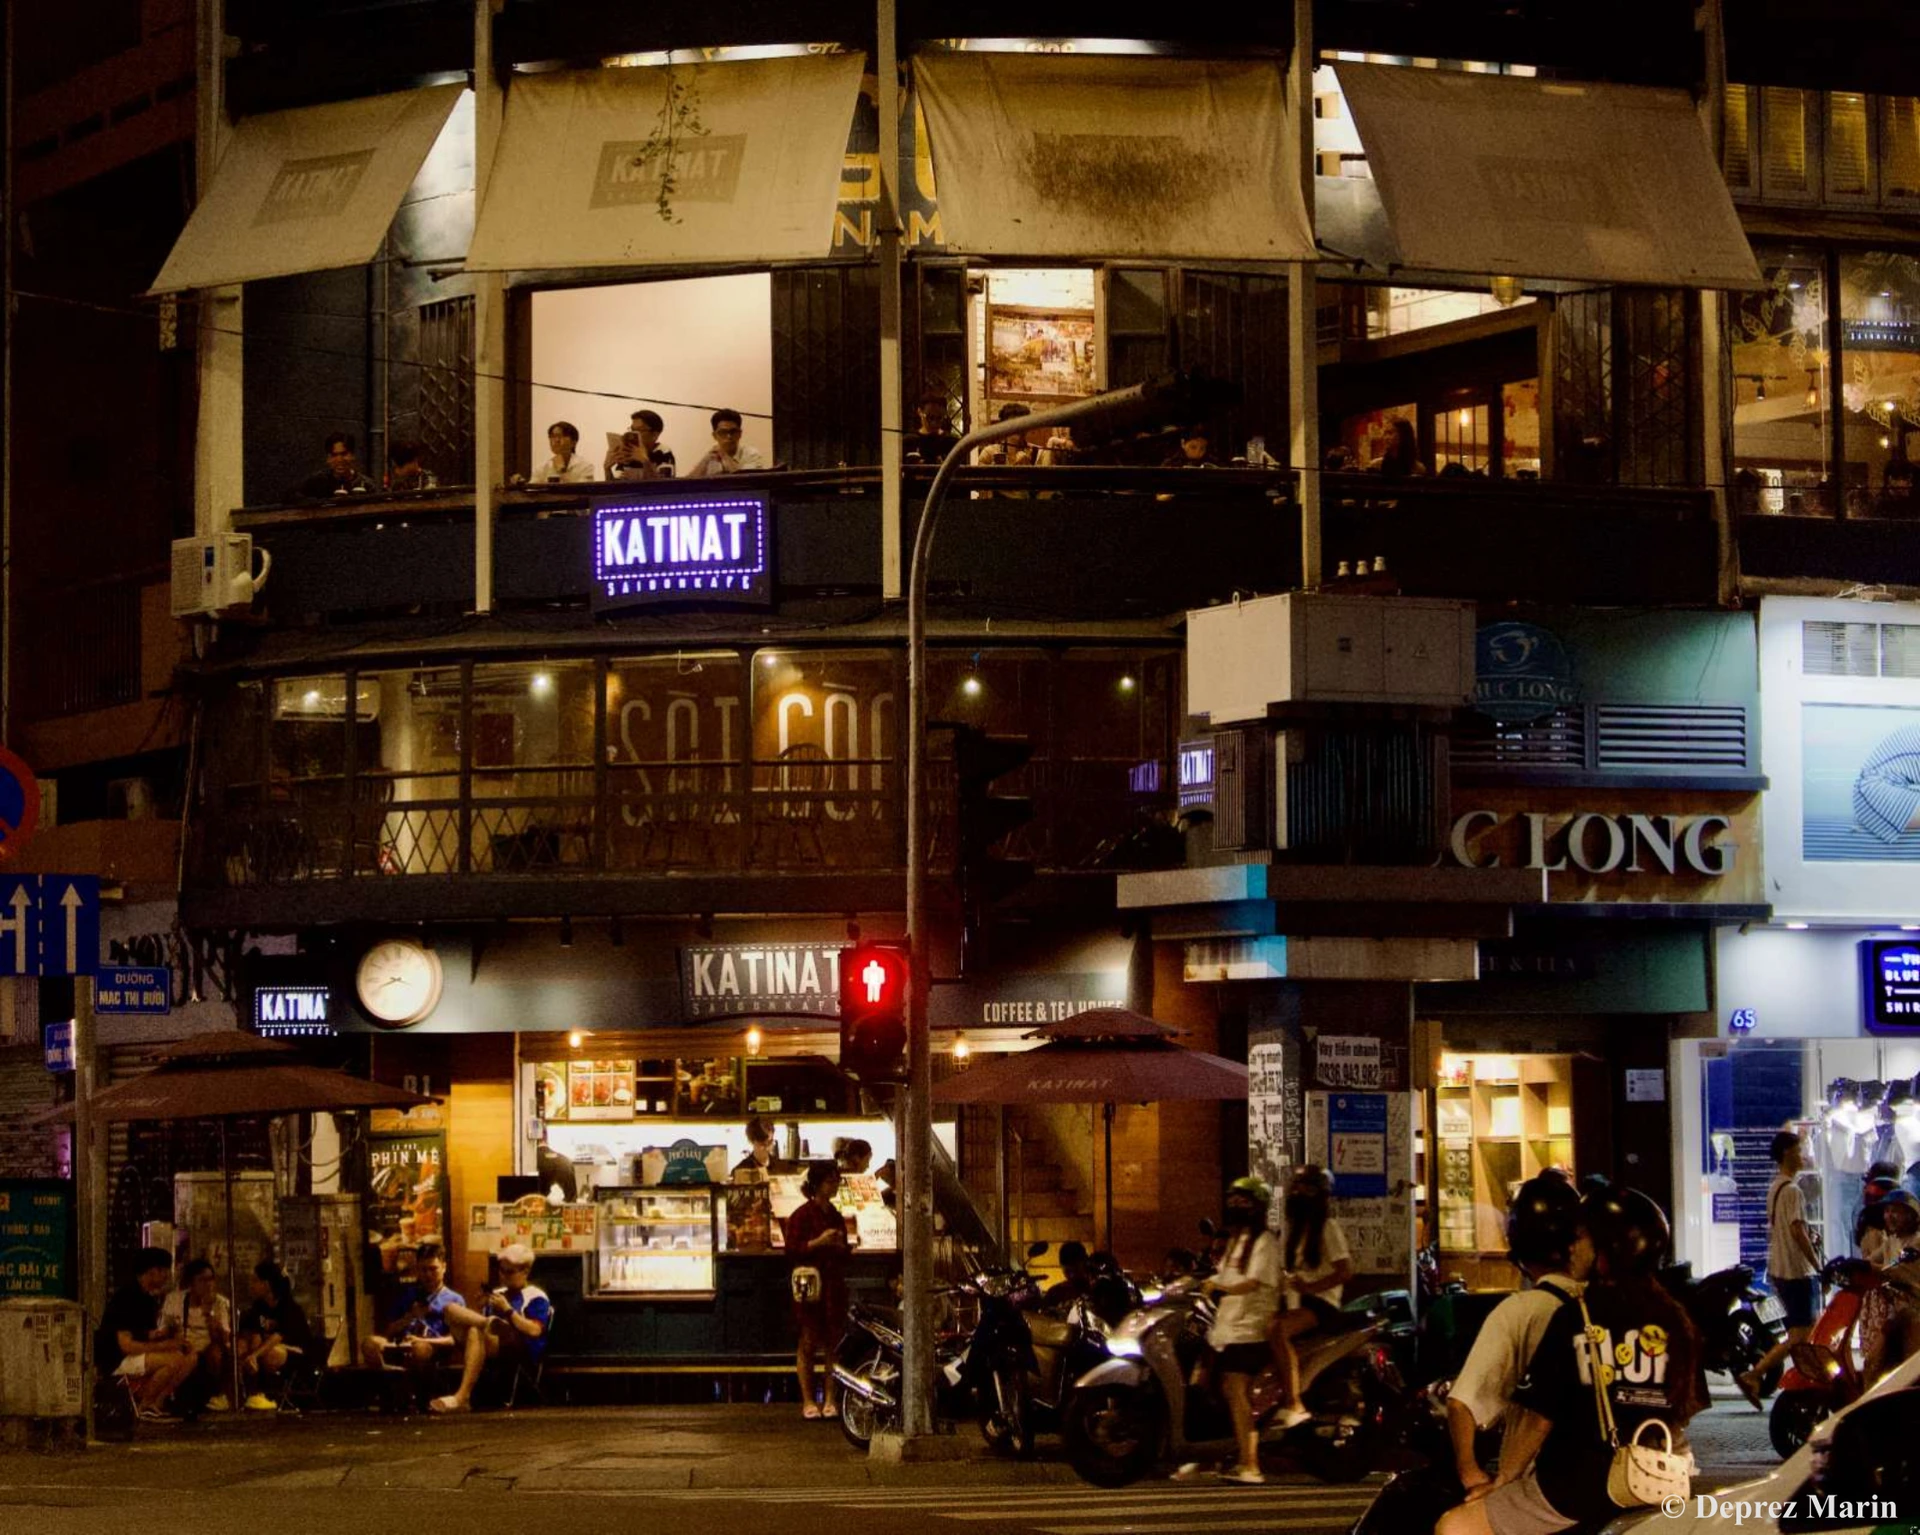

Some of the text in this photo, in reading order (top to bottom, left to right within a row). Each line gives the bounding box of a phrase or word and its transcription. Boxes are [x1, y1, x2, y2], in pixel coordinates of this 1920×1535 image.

[603, 513, 748, 566] KATINAT
[1522, 811, 1738, 876] LONG
[692, 948, 841, 996] KATINAT
[261, 993, 330, 1021] KATINA
[983, 1002, 1033, 1022] COFFEE
[1036, 1002, 1048, 1022] &
[1732, 1008, 1758, 1028] 65
